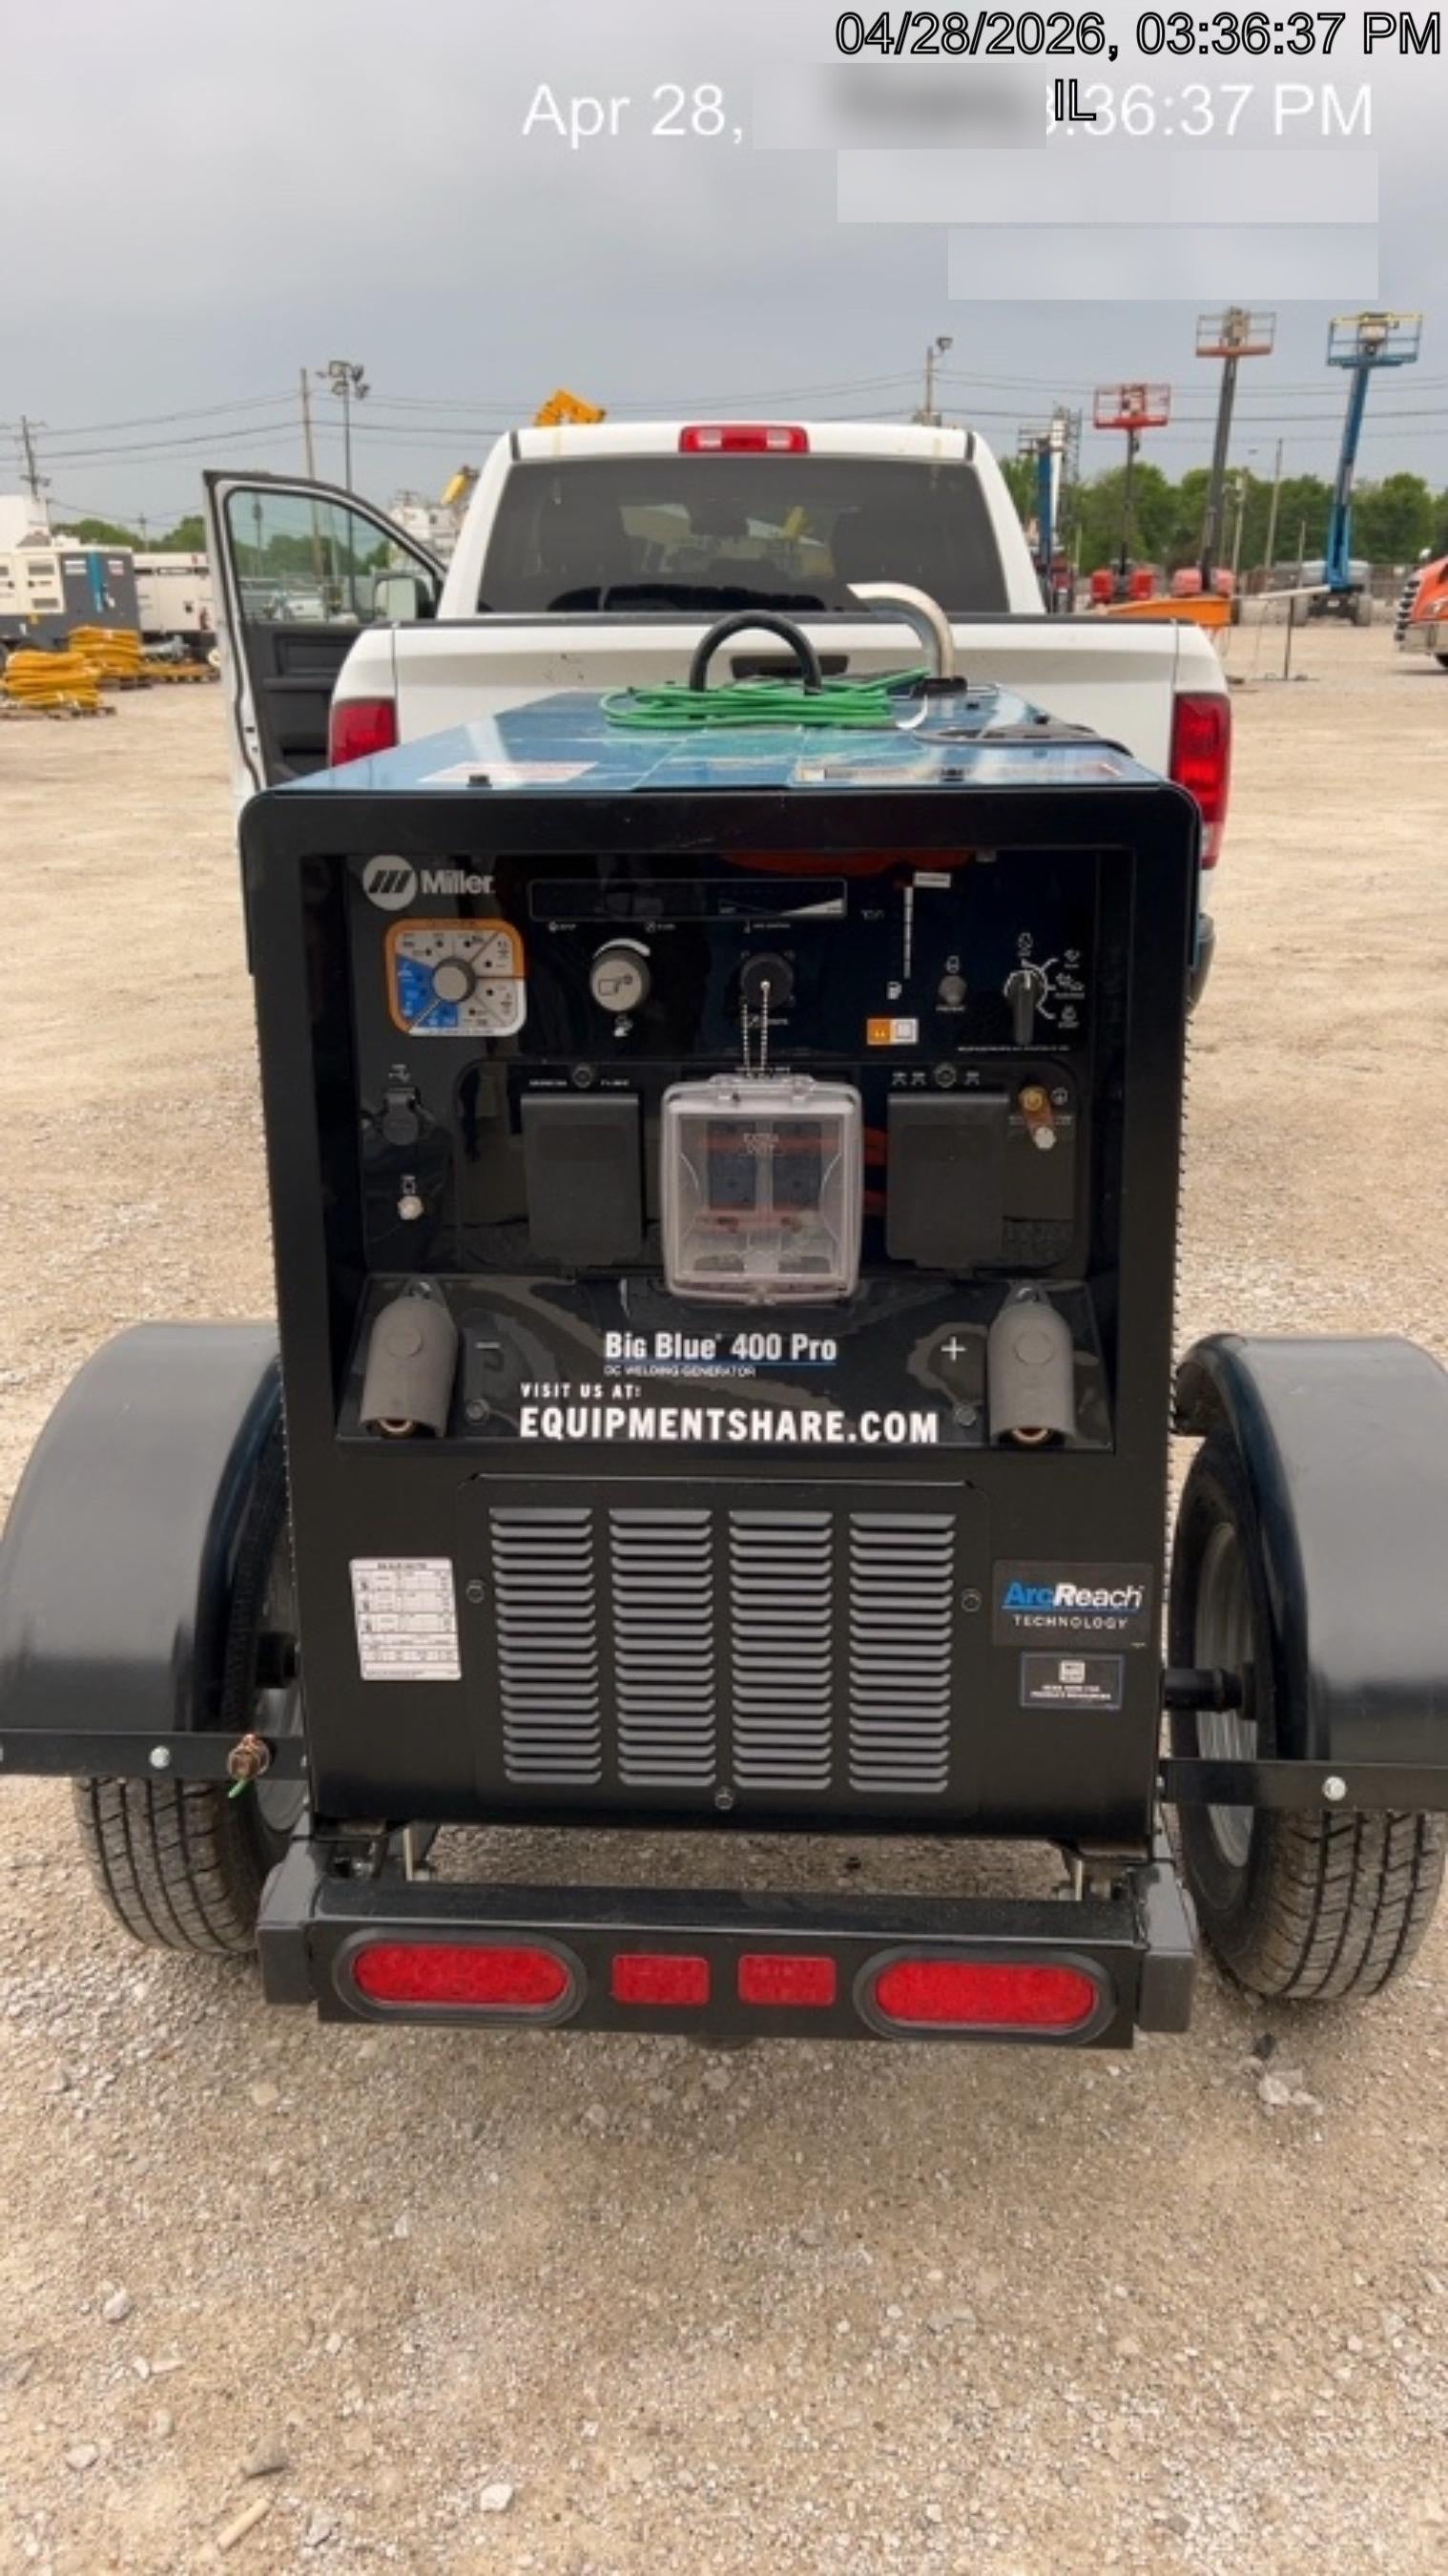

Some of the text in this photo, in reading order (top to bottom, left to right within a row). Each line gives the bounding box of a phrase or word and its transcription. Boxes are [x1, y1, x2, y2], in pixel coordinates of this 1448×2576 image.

[420, 868, 495, 895] Miller
[604, 1331, 838, 1361] Big Blue 400 Pro
[604, 1364, 621, 1376] DC
[520, 1381, 642, 1401] VISIT US AT:
[519, 1406, 940, 1444] EQUIPMENTSHARE.COM
[1004, 1580, 1143, 1610] ArcReach
[1013, 1613, 1129, 1631] TECHNOLOGY
